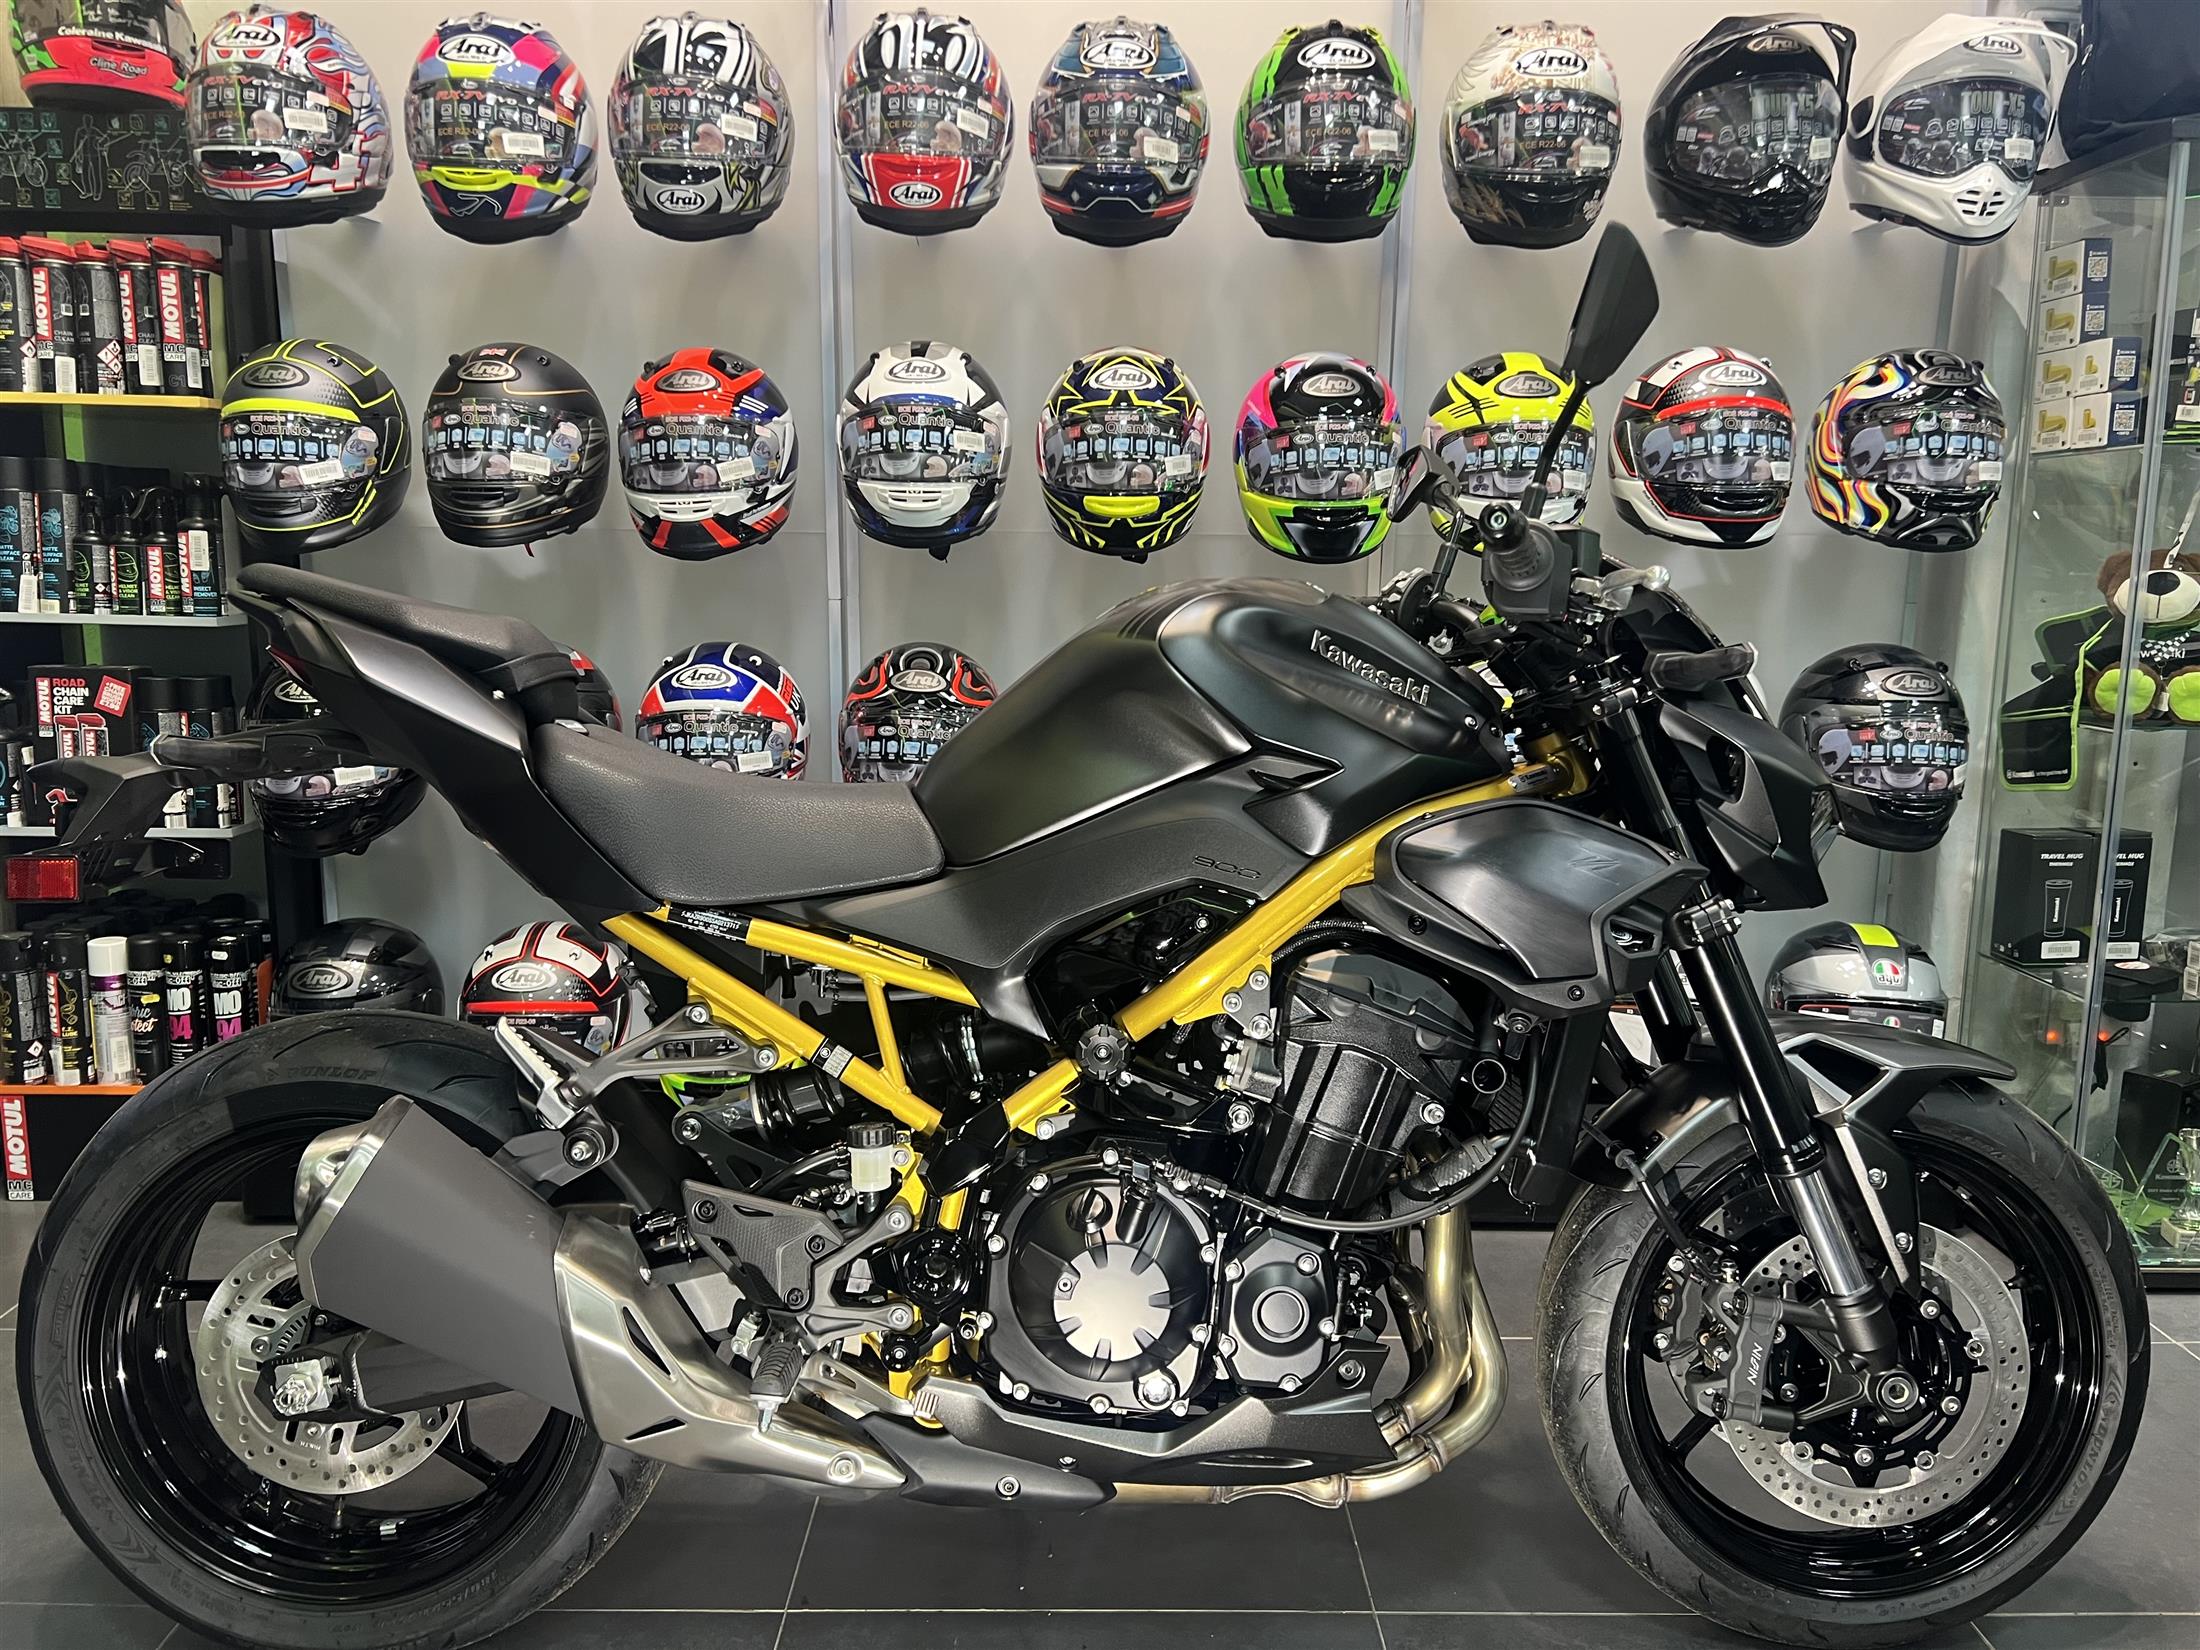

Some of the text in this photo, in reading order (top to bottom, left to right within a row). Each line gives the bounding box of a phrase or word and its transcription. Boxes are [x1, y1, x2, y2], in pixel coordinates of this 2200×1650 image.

[57, 25, 115, 40] Coleraine
[448, 38, 501, 55] Arai
[1969, 35, 2017, 52] Arai
[1305, 44, 1365, 62] Arai
[1527, 52, 1580, 69] Arai
[89, 57, 148, 76] Cline Road
[659, 190, 701, 207] Arai
[895, 183, 936, 201] Arai
[33, 269, 50, 339] MOTUL
[119, 271, 136, 343] MOTUL
[160, 271, 182, 340] MOTUL
[164, 344, 186, 354] MC
[250, 366, 297, 381] Arai
[464, 363, 510, 377] Arai
[896, 362, 939, 378] Arai
[1103, 369, 1146, 383] Arai
[1718, 366, 1757, 380] Arai
[668, 373, 711, 386] Arai
[1314, 374, 1353, 390] Arai
[1508, 376, 1551, 392] Arai
[666, 423, 723, 437] Quantic
[178, 534, 191, 594] MOTUL
[147, 549, 163, 597] MOTUL
[1310, 629, 1430, 706] Kawasaki
[53, 678, 86, 687] ROAD
[682, 669, 726, 683] Arai
[899, 671, 941, 687] Arai
[1895, 675, 1939, 689] Arai
[53, 687, 89, 697] CHAIN
[37, 679, 51, 723] MOTUL
[53, 697, 84, 706] CARE
[54, 705, 72, 714] KIT
[683, 720, 739, 734] Quantic
[302, 970, 342, 985] Arai
[499, 969, 545, 985] Arai
[47, 975, 58, 1034] MOTUL
[213, 990, 242, 1016] MO
[3, 1099, 28, 1176] MOTUL
[8, 1180, 33, 1191] MC
[1746, 1341, 1763, 1386] NISSIN
